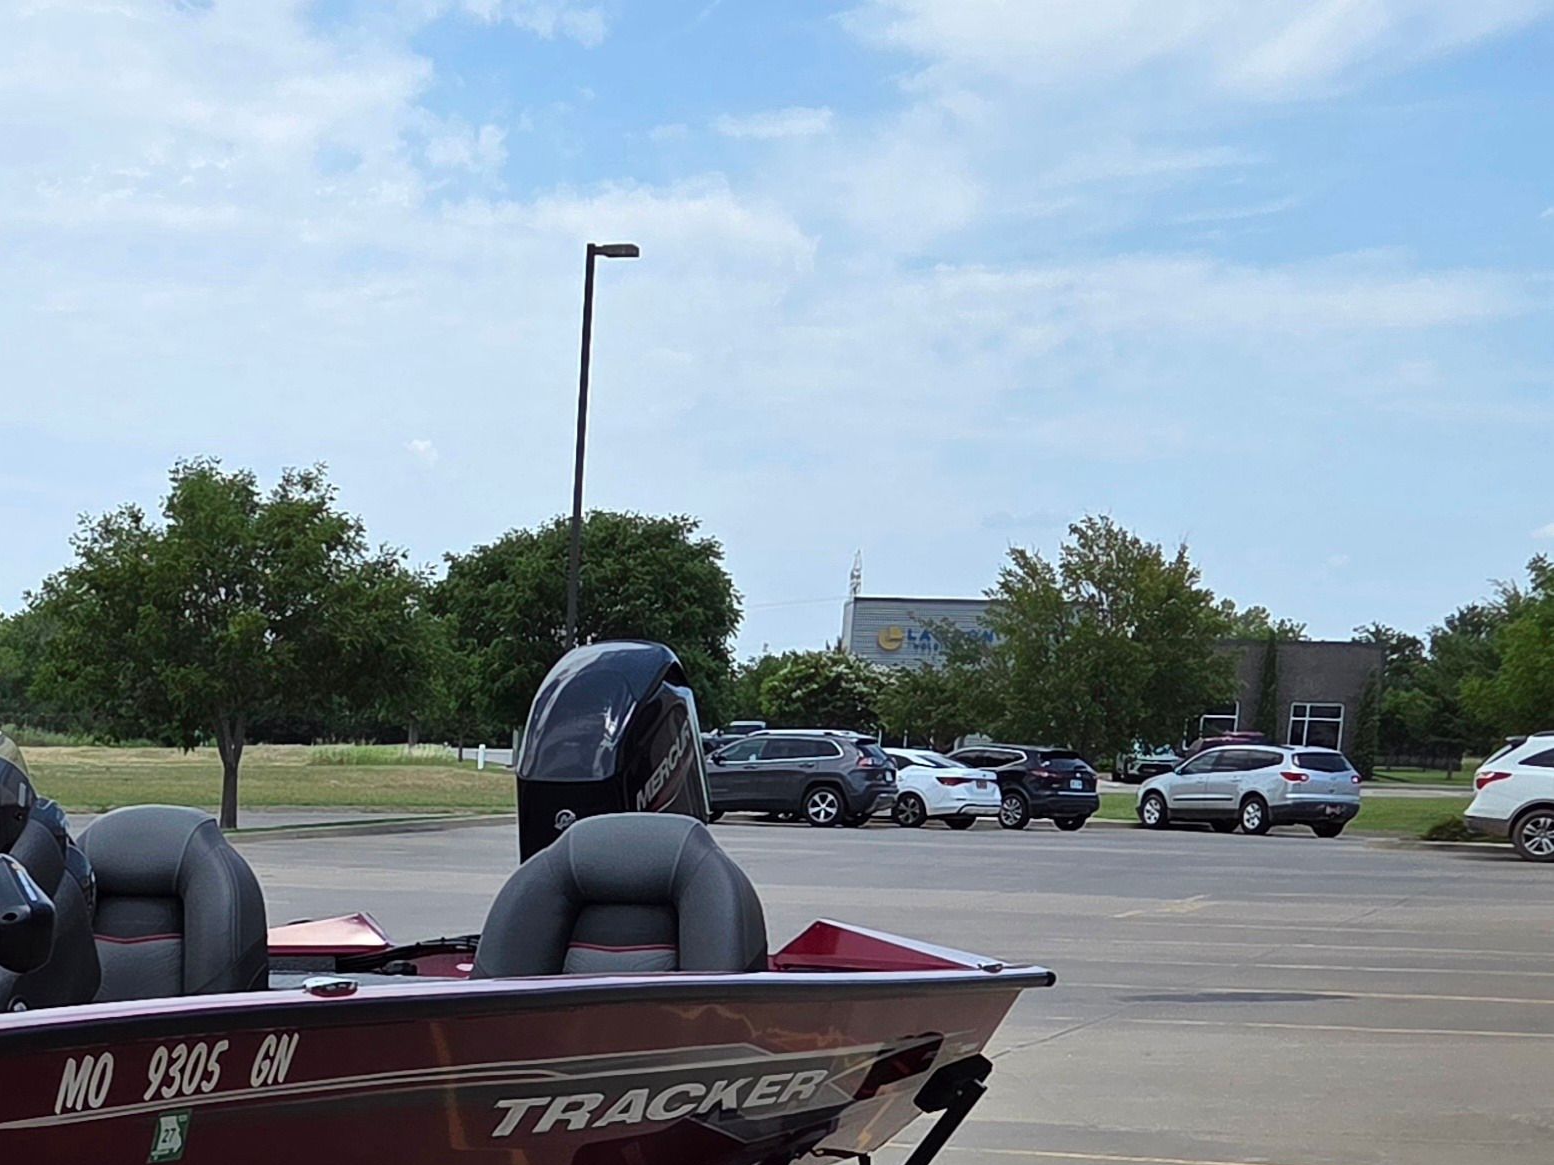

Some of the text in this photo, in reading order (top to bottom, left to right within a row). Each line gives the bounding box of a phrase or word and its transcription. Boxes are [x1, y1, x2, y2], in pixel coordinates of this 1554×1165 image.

[636, 716, 692, 811] MERCUR
[55, 1033, 299, 1115] MO 9305 GN
[492, 1070, 828, 1137] TRACKER
[161, 1127, 177, 1144] 27
